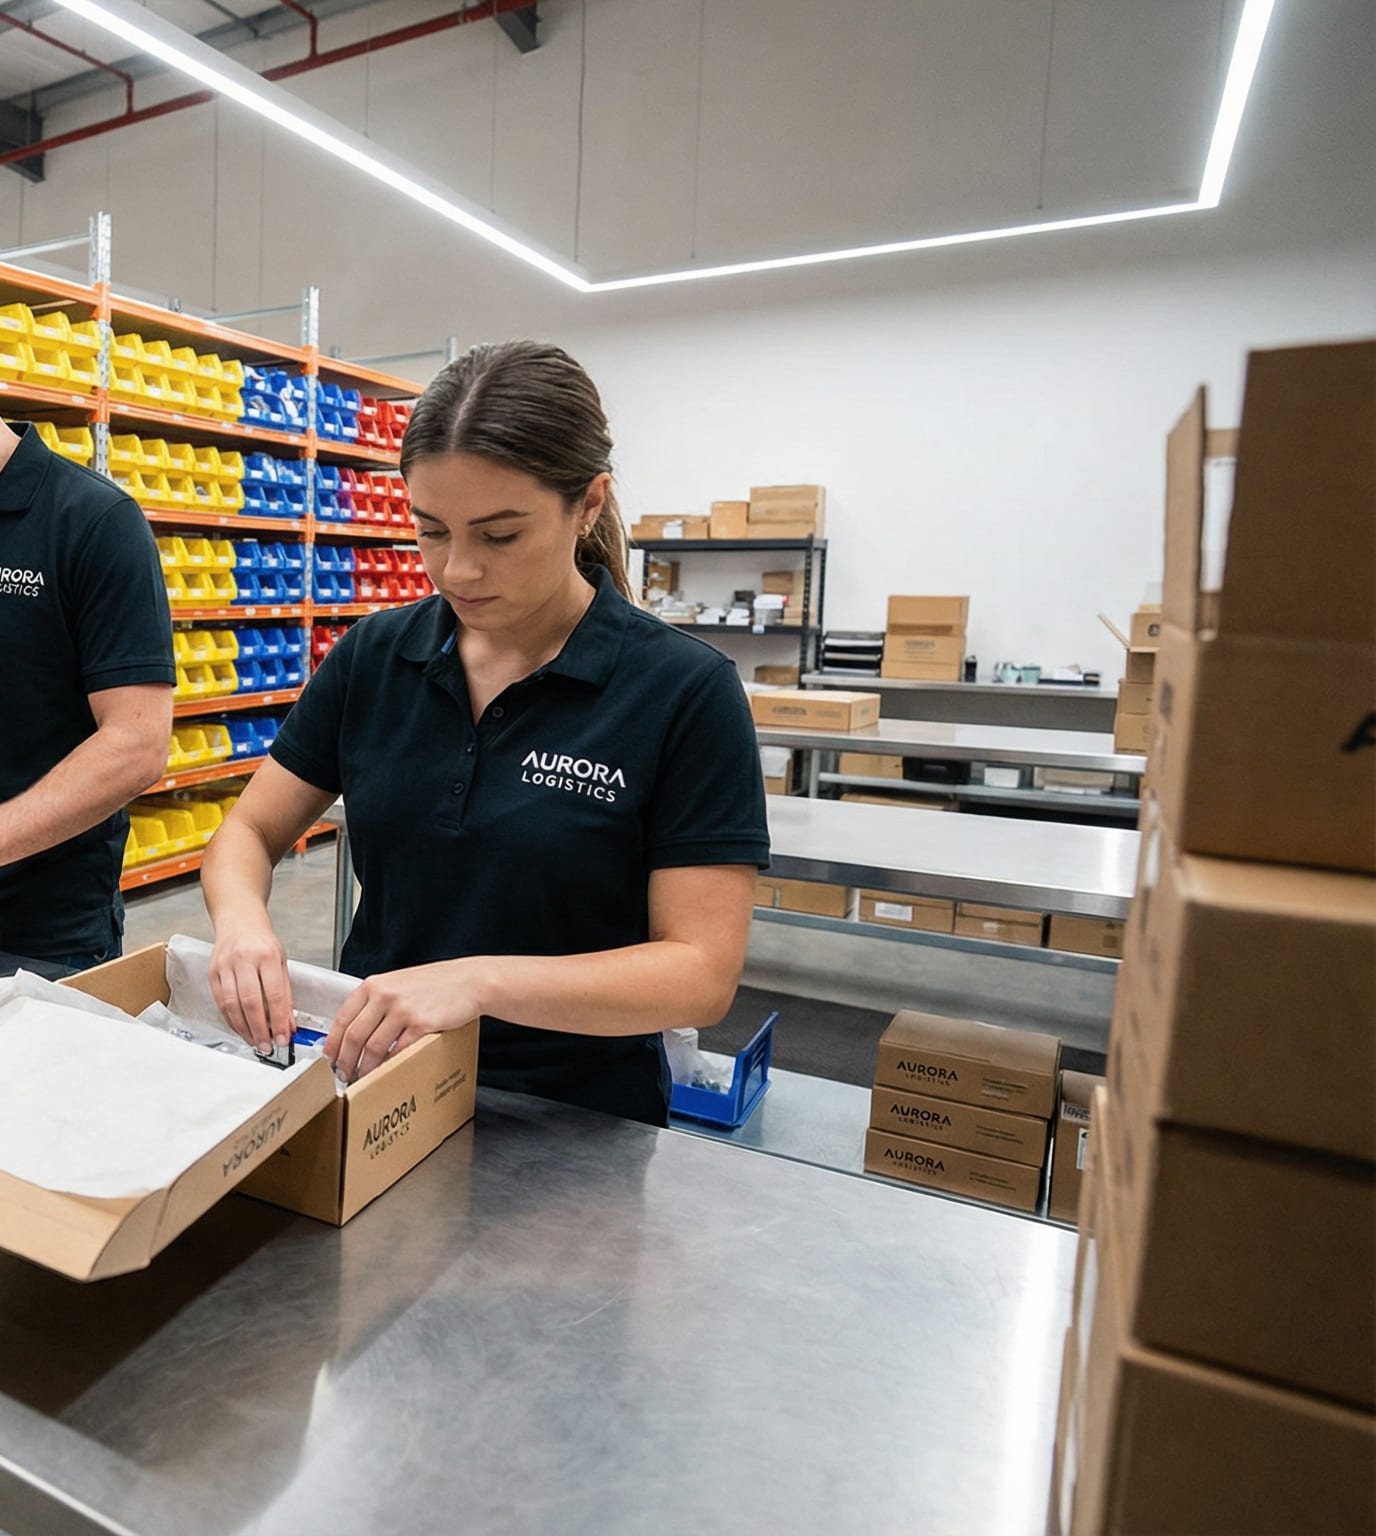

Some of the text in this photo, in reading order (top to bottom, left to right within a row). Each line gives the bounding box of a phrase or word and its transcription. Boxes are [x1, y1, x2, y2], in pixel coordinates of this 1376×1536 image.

[521, 750, 627, 788] AURORA
[521, 770, 616, 803] LOGISTICS
[896, 1060, 958, 1081] AURORA
[363, 1095, 417, 1151] AURORA
[890, 1103, 952, 1127] AURORA
[884, 1148, 945, 1172] AURORA
